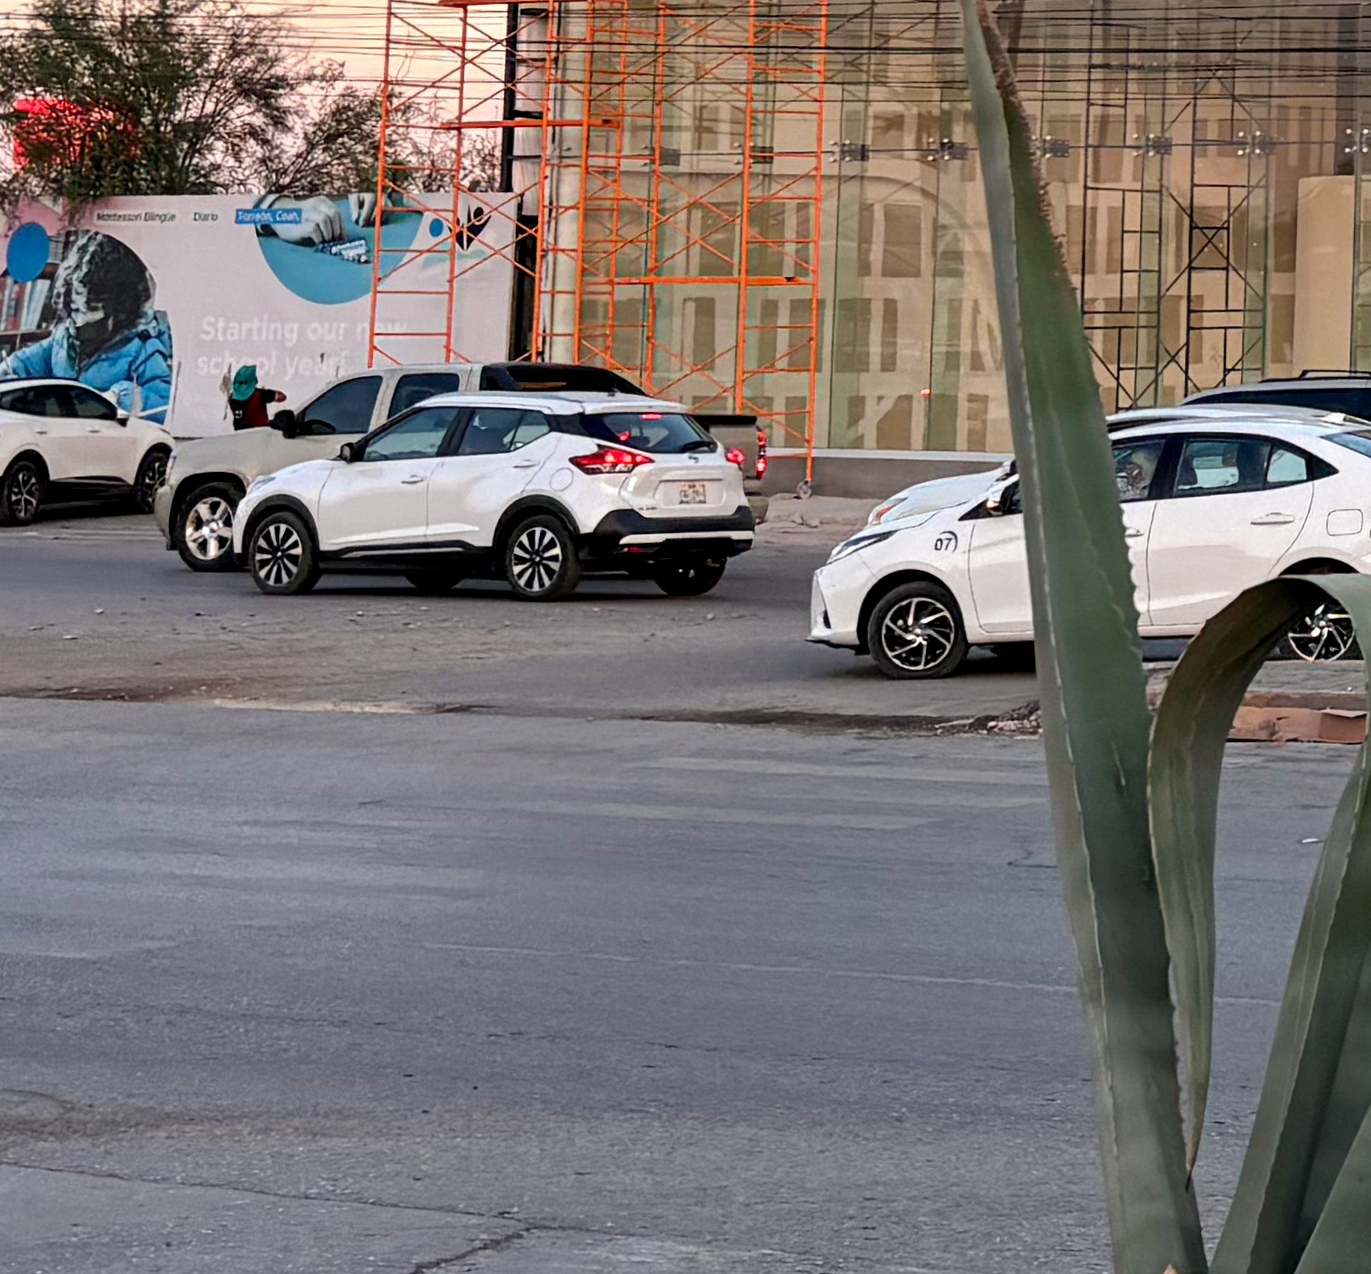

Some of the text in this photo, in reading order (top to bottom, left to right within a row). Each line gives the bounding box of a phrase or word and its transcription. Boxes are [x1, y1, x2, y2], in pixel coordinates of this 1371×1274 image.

[201, 313, 300, 347] Starting
[307, 320, 347, 341] our
[934, 537, 953, 551] 07
